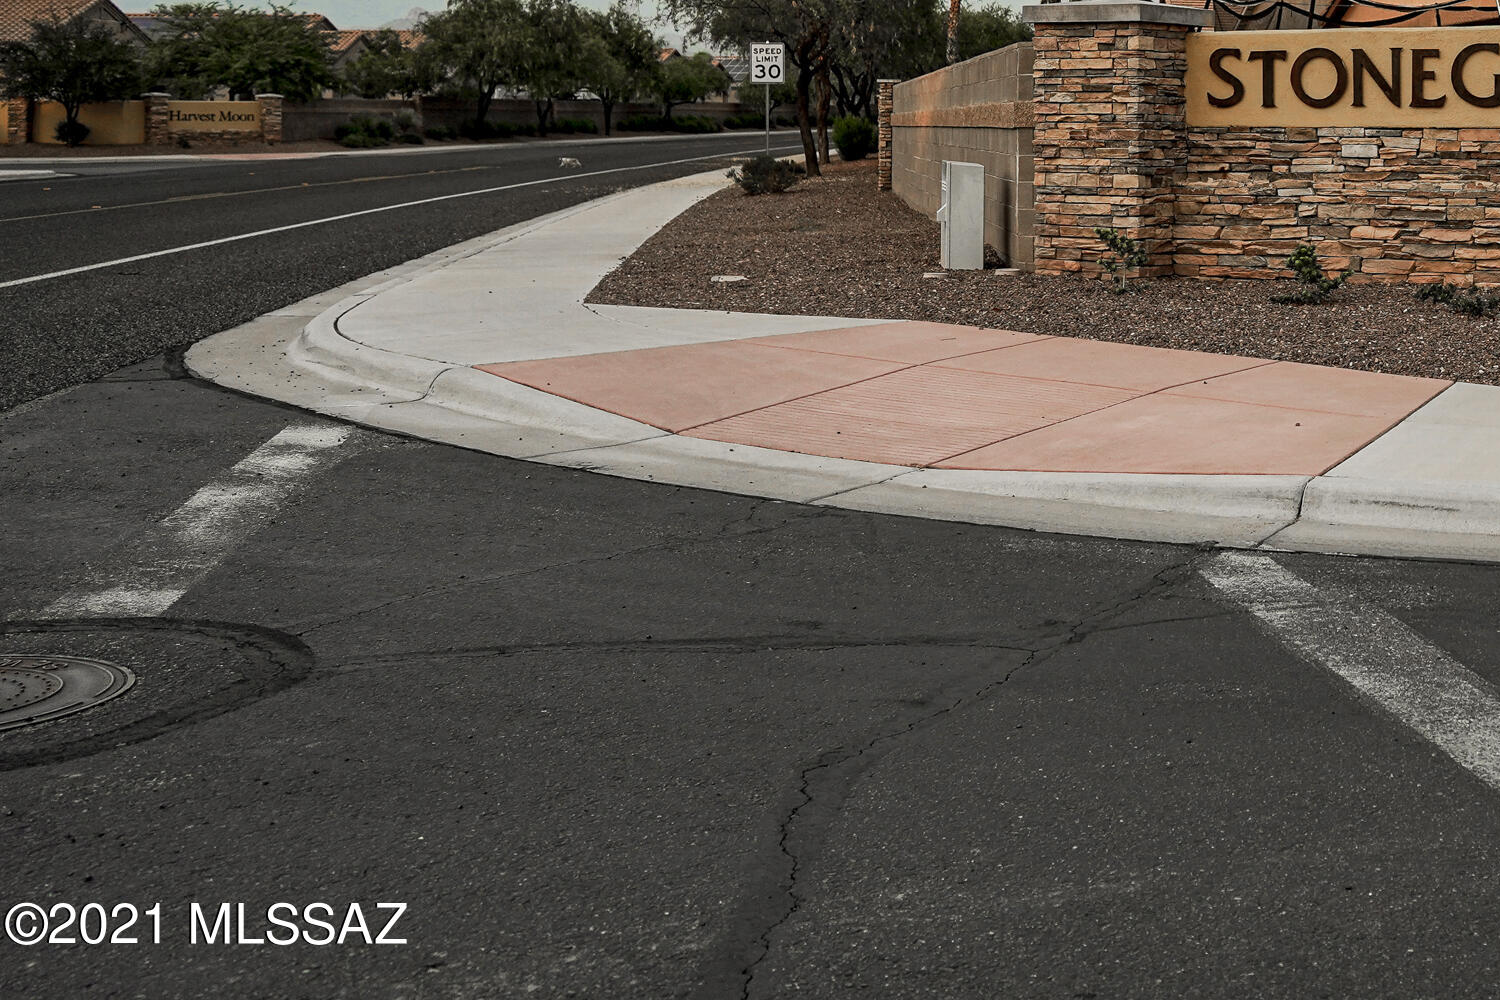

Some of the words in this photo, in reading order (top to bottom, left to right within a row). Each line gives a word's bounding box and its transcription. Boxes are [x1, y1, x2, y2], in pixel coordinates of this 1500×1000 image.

[754, 64, 781, 79] 30
[168, 110, 216, 122] Harvest
[218, 110, 255, 122] Moon
